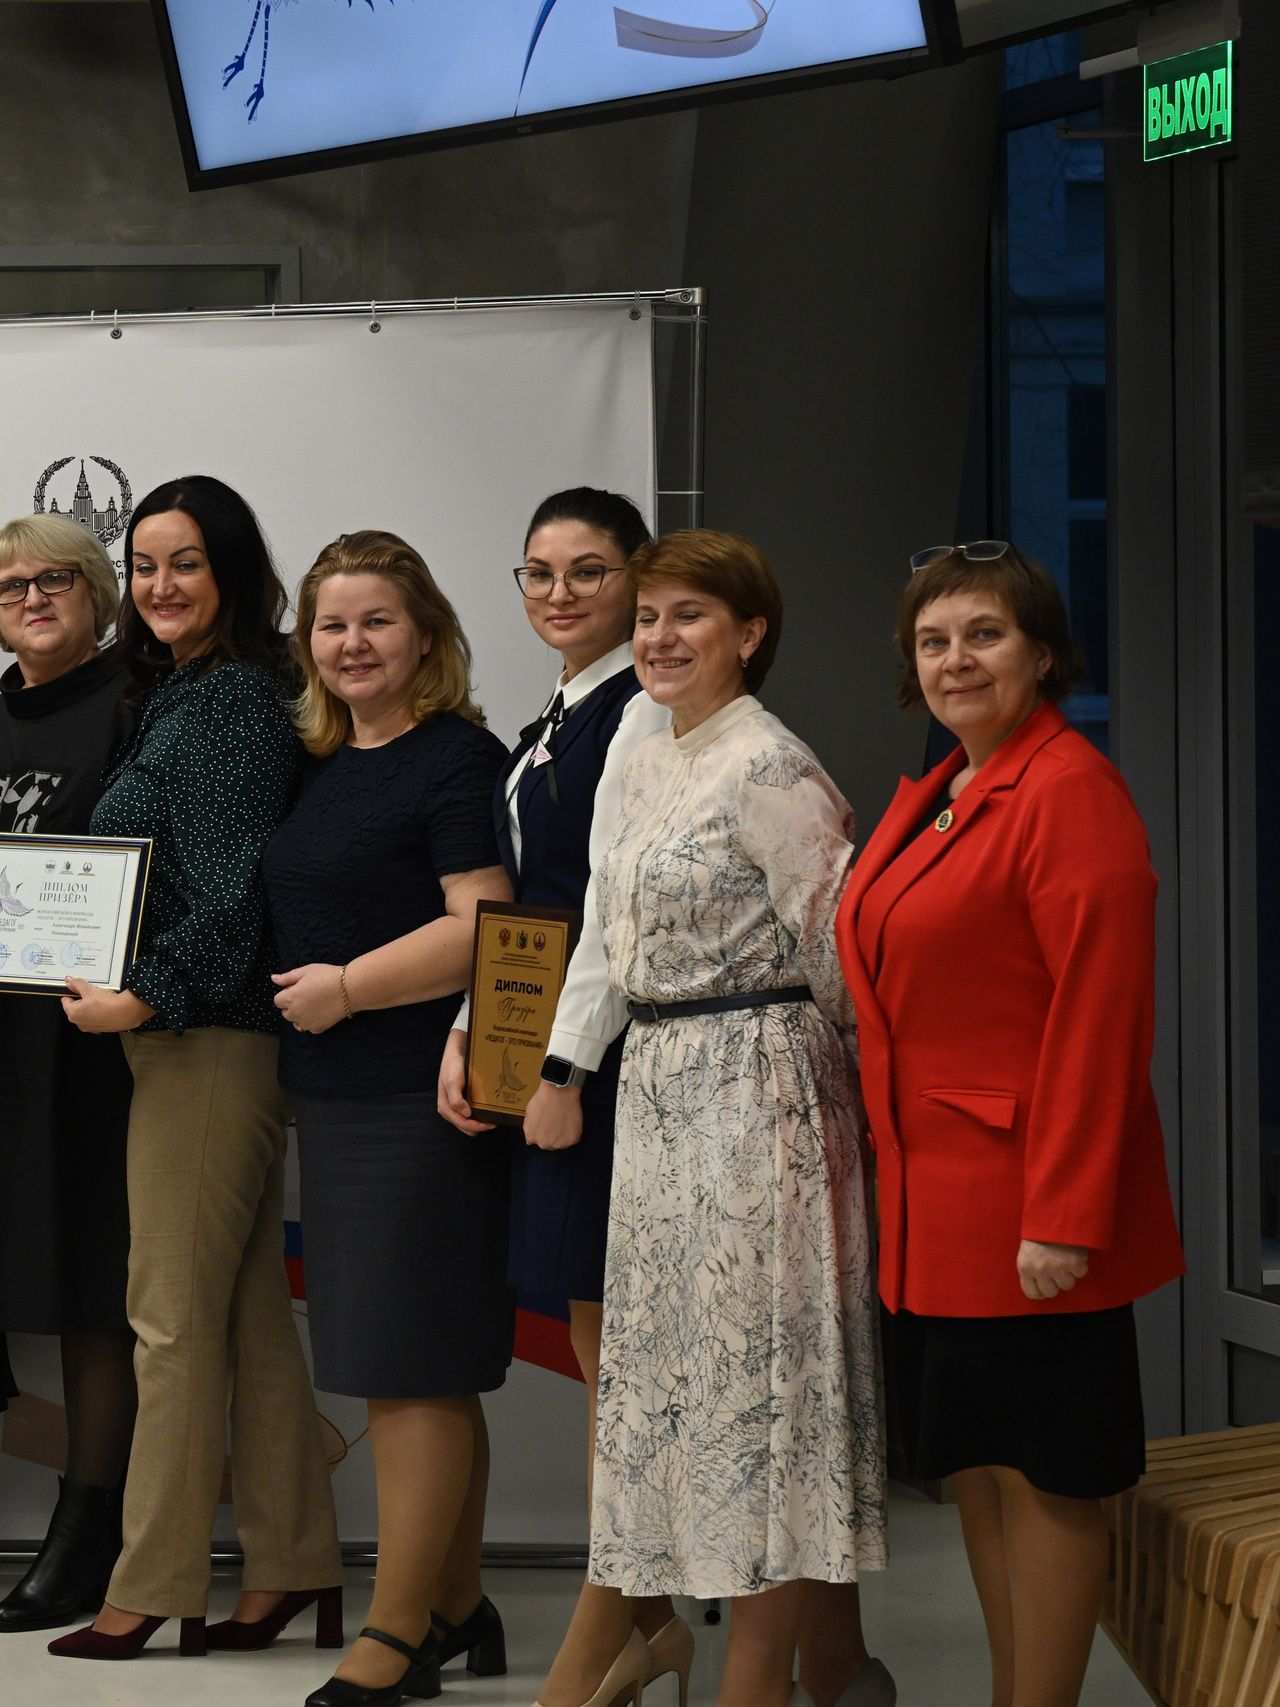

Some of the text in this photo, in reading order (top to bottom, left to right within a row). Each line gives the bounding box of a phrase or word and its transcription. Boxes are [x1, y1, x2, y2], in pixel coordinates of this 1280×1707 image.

[1148, 67, 1227, 142] ВЫХОД
[40, 881, 88, 892] ДИПЛОМ
[39, 892, 88, 904] ПРИЗЁРА
[495, 979, 543, 996] ДИПЛОМ
[497, 997, 536, 1024] Призёра
